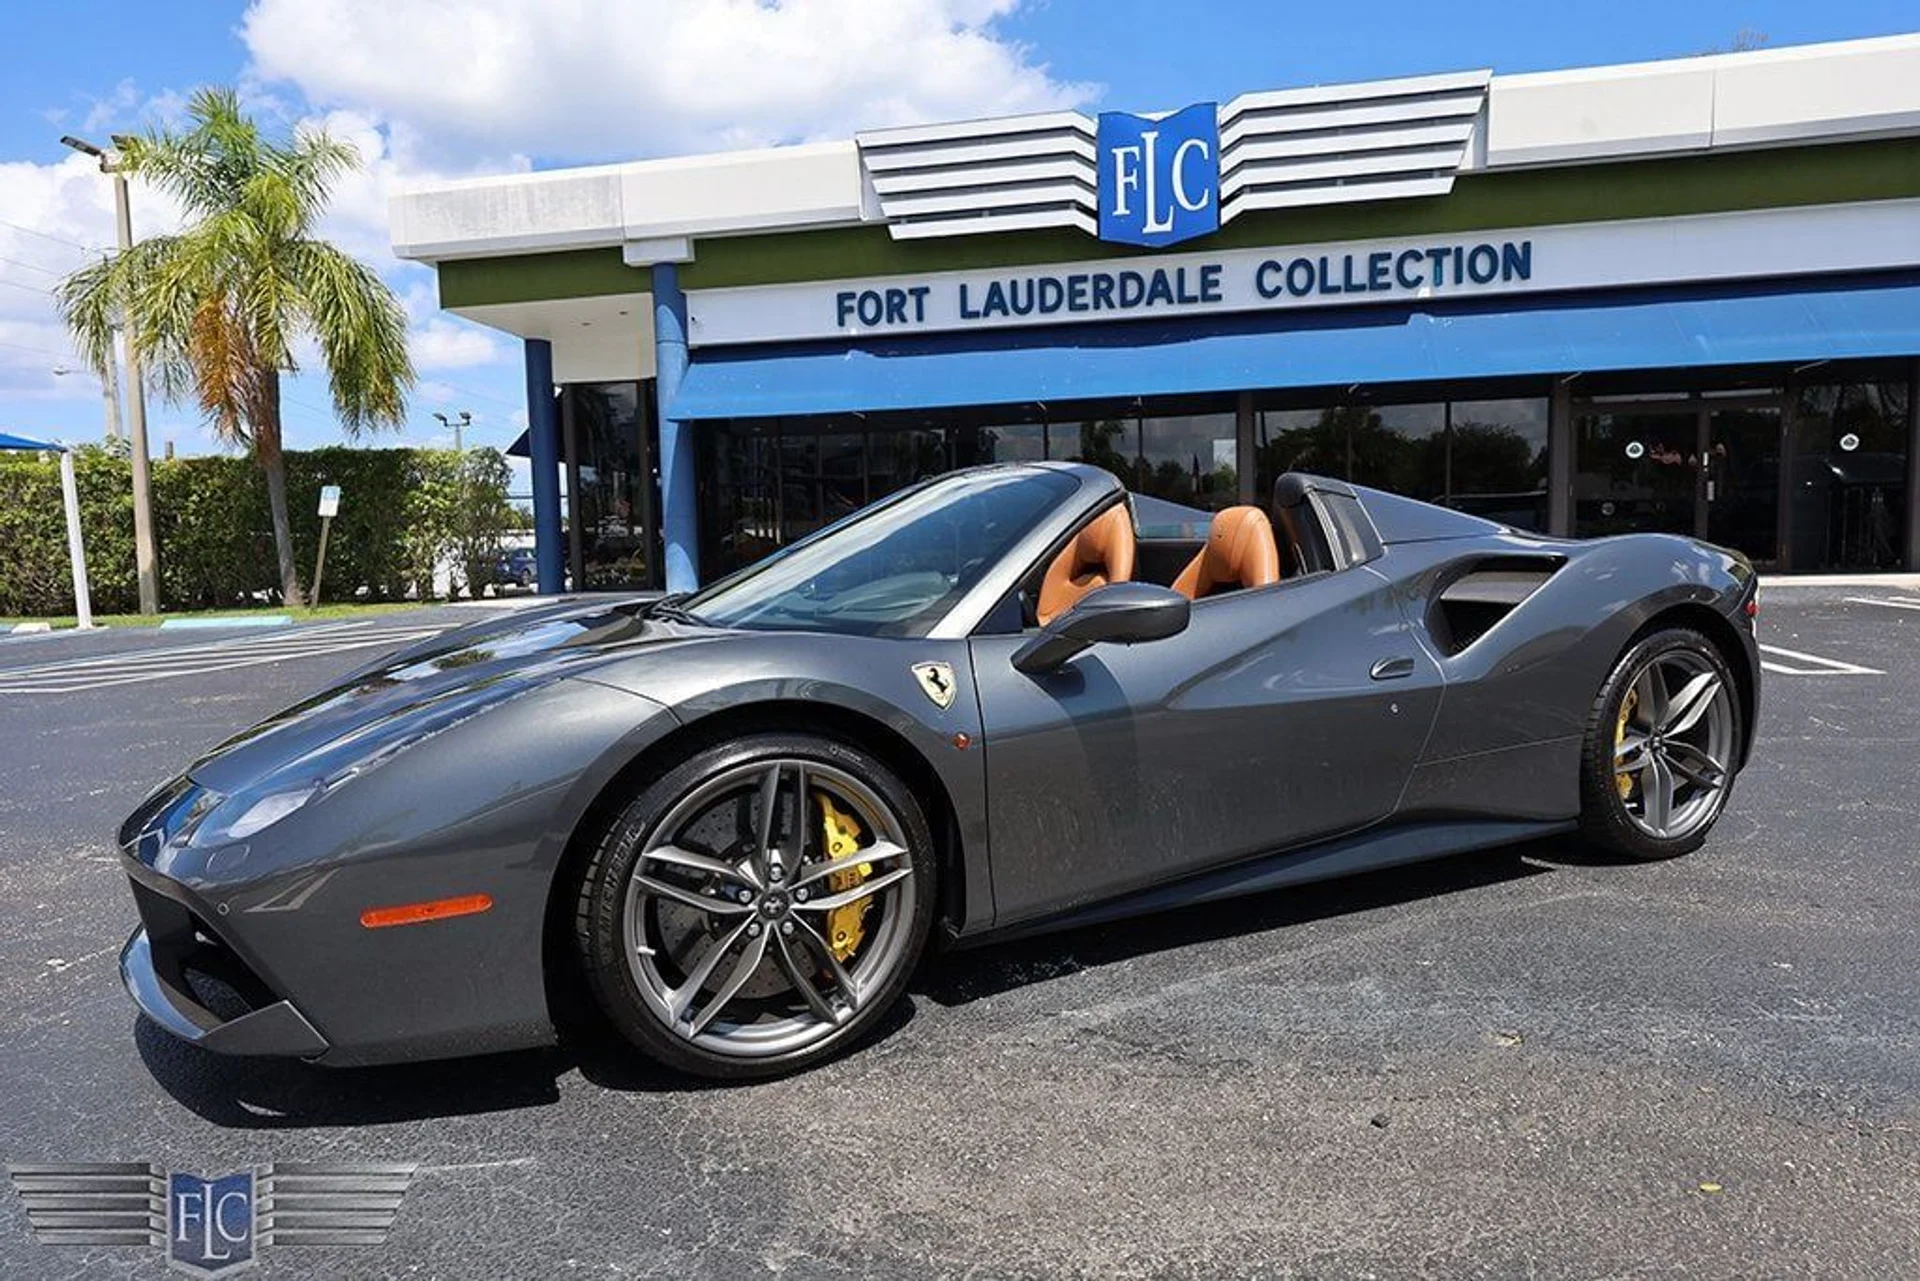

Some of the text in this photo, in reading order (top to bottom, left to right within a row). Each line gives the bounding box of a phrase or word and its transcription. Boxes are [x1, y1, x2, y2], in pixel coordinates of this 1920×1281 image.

[1111, 131, 1209, 234] FLC
[837, 241, 1532, 327] FORT LAUDERDALE COLLECTION
